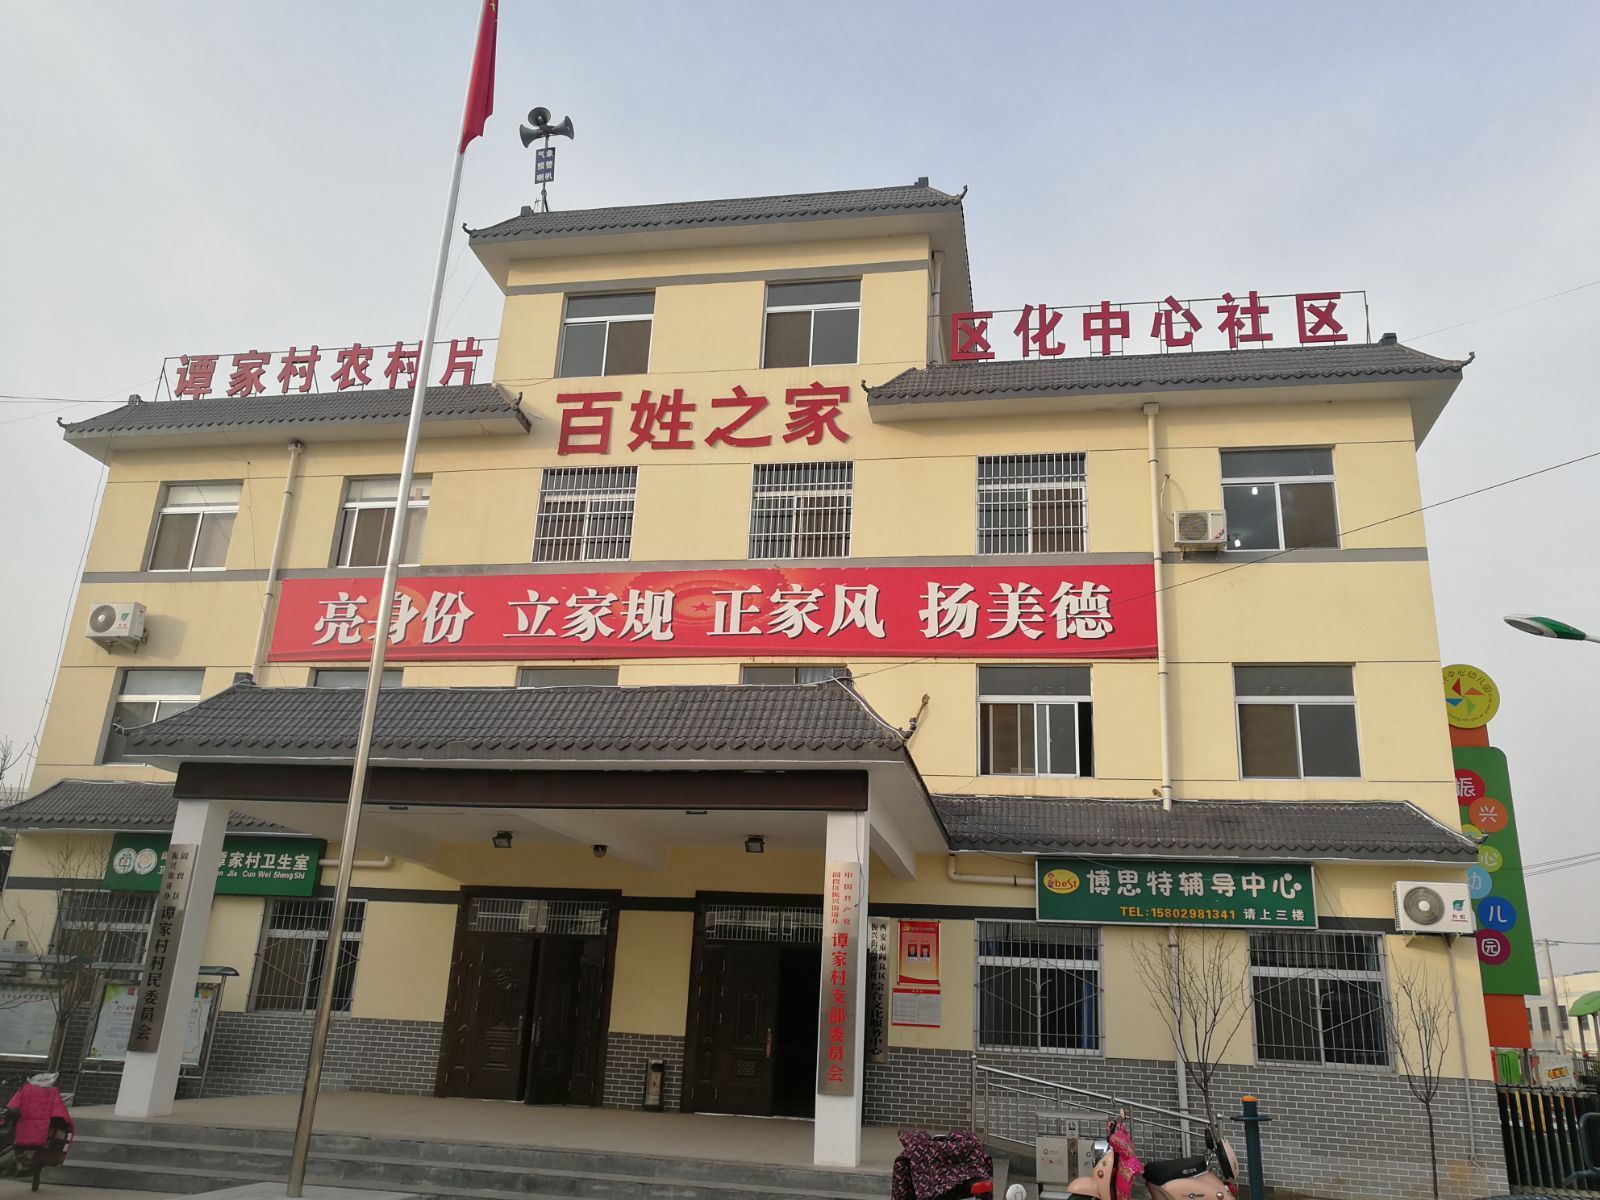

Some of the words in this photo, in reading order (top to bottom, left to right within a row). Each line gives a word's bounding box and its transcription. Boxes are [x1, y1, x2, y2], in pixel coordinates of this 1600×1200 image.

[951, 291, 1348, 361] 区化中心社区
[174, 337, 483, 399] 谭家村农村片
[557, 381, 851, 456] 百姓之家
[502, 588, 675, 642] 立家规
[706, 584, 885, 639] 正家风
[918, 580, 1114, 640] 扬美德
[242, 870, 256, 878] Cun
[1086, 869, 1303, 899] 博思特辅导中心
[1242, 908, 1305, 922] 请上三楼
[137, 906, 176, 1040] 谭家村村民委员会
[828, 932, 849, 1083] 谭家村支部委员会
